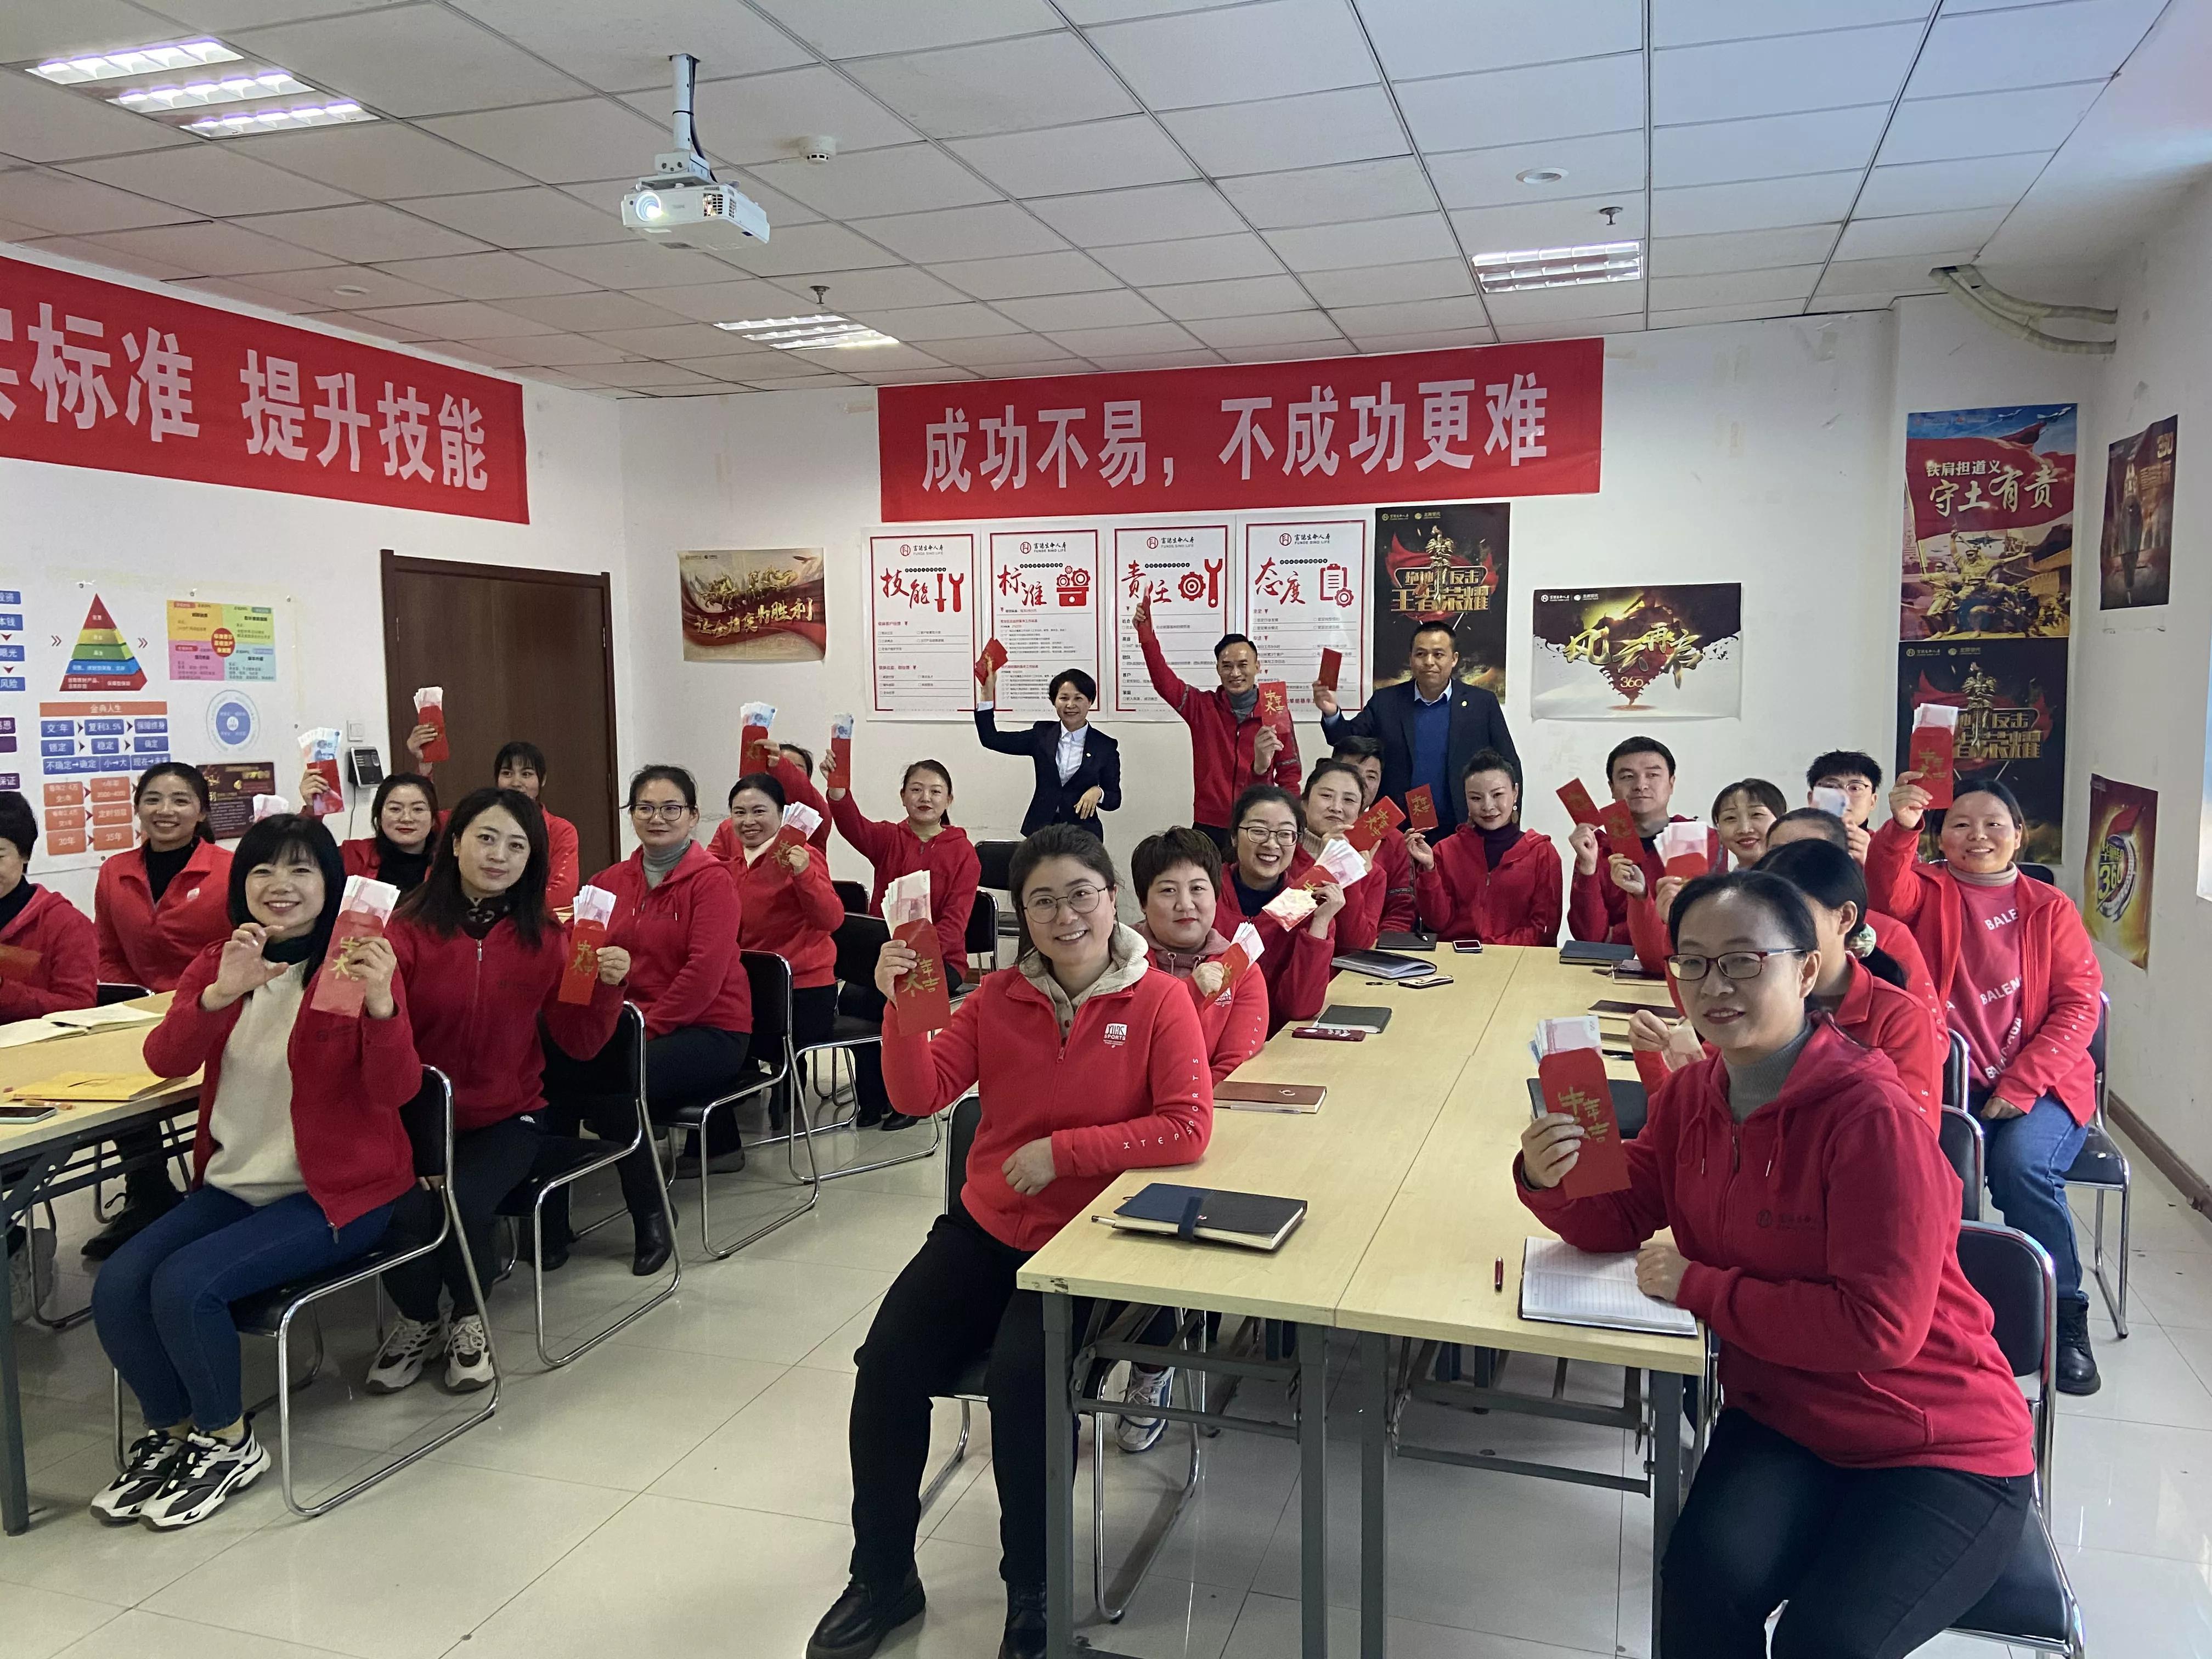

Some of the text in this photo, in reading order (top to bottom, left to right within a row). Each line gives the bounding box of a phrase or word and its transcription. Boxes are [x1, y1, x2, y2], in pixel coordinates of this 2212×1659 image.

[0, 302, 488, 492] 标准 提升技能
[1926, 459, 2001, 477] 铁肩担道义
[1929, 464, 2058, 518] 守土有责
[880, 567, 930, 609] 技能
[997, 564, 1047, 607] 标准
[1121, 560, 1172, 603] 责任
[1255, 556, 1306, 605] 态度
[1391, 585, 1490, 612] 王者荣耀
[1, 679, 18, 689] 风险
[1620, 676, 1644, 688] 360
[2098, 864, 2123, 900] 360
[1984, 907, 2018, 931] BALE
